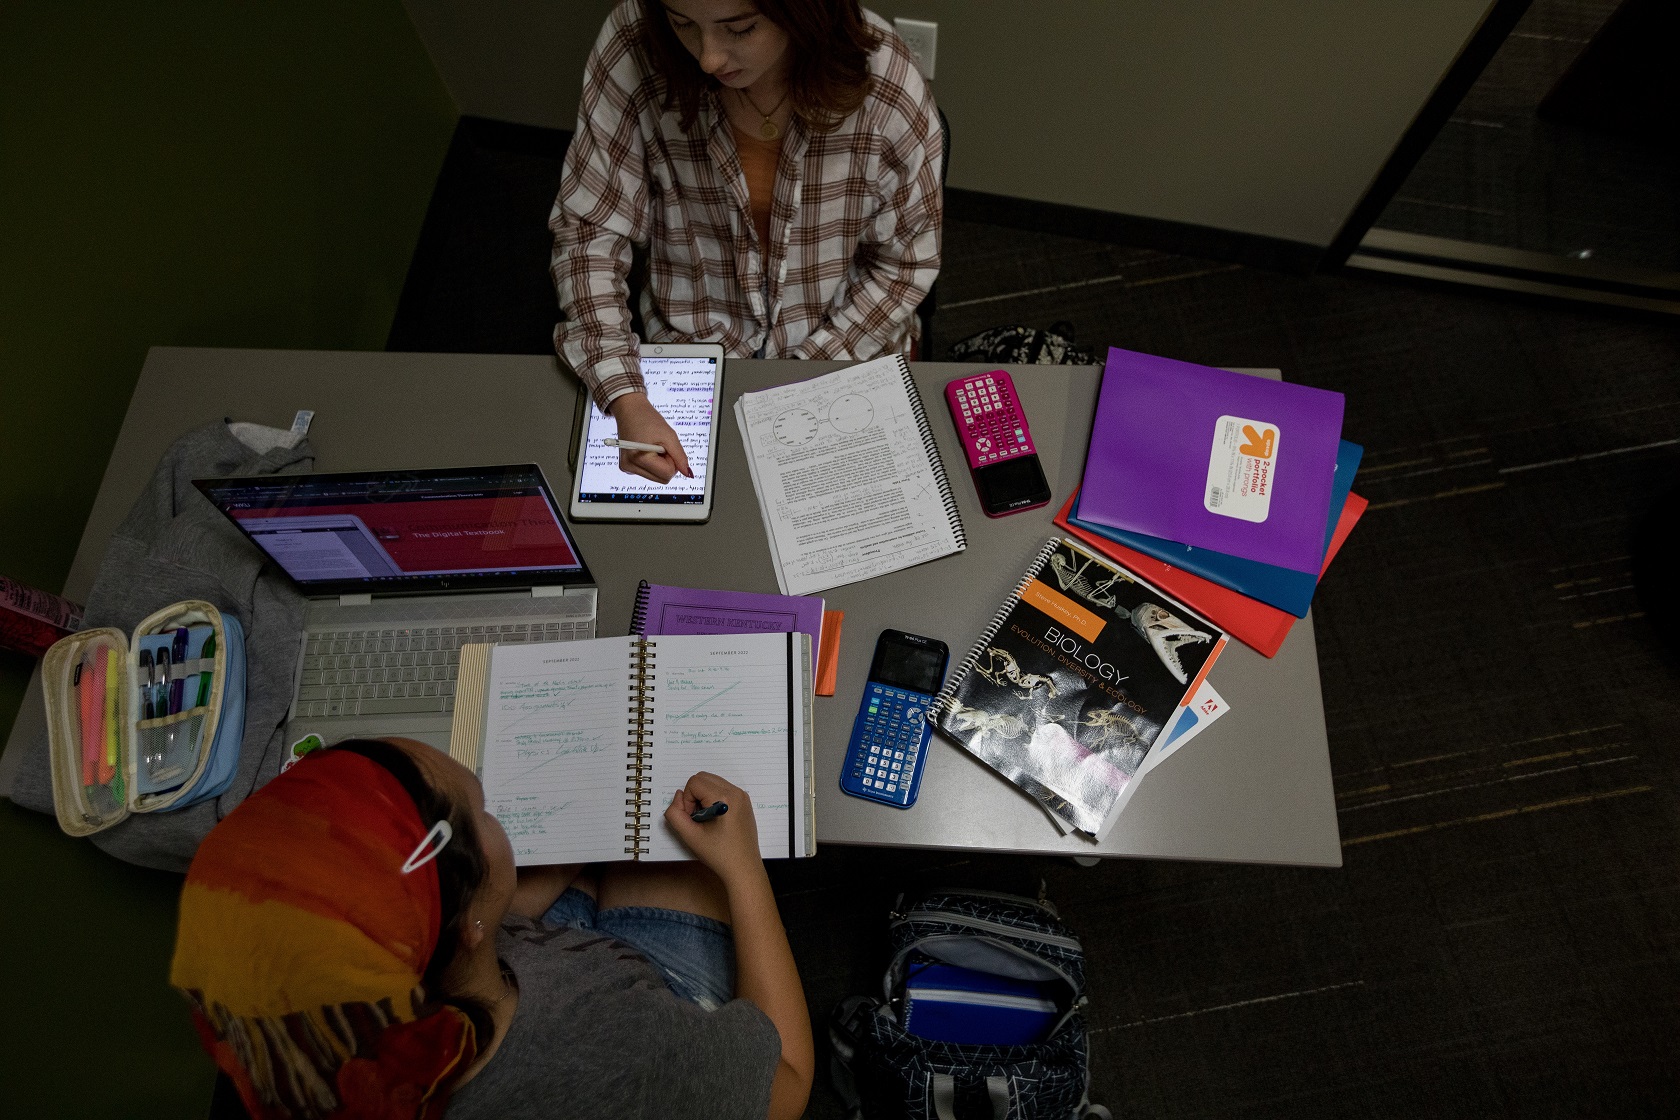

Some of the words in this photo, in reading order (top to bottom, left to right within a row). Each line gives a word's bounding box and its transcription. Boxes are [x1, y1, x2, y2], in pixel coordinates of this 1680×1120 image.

[1240, 472, 1250, 497] prongs
[1250, 459, 1260, 493] portfolio
[1259, 461, 1271, 496] 2-pocket
[432, 530, 463, 539] Digital
[463, 528, 505, 537] Textbook
[676, 614, 726, 627] WESTERN
[727, 619, 783, 631] KENTUCKY
[1010, 623, 1056, 659] EVOLUTION,
[1057, 654, 1099, 685] DIVERSITY
[1099, 682, 1106, 691] &
[1105, 685, 1148, 715] ECOLOGY
[1043, 626, 1130, 686] BIOLOGY
